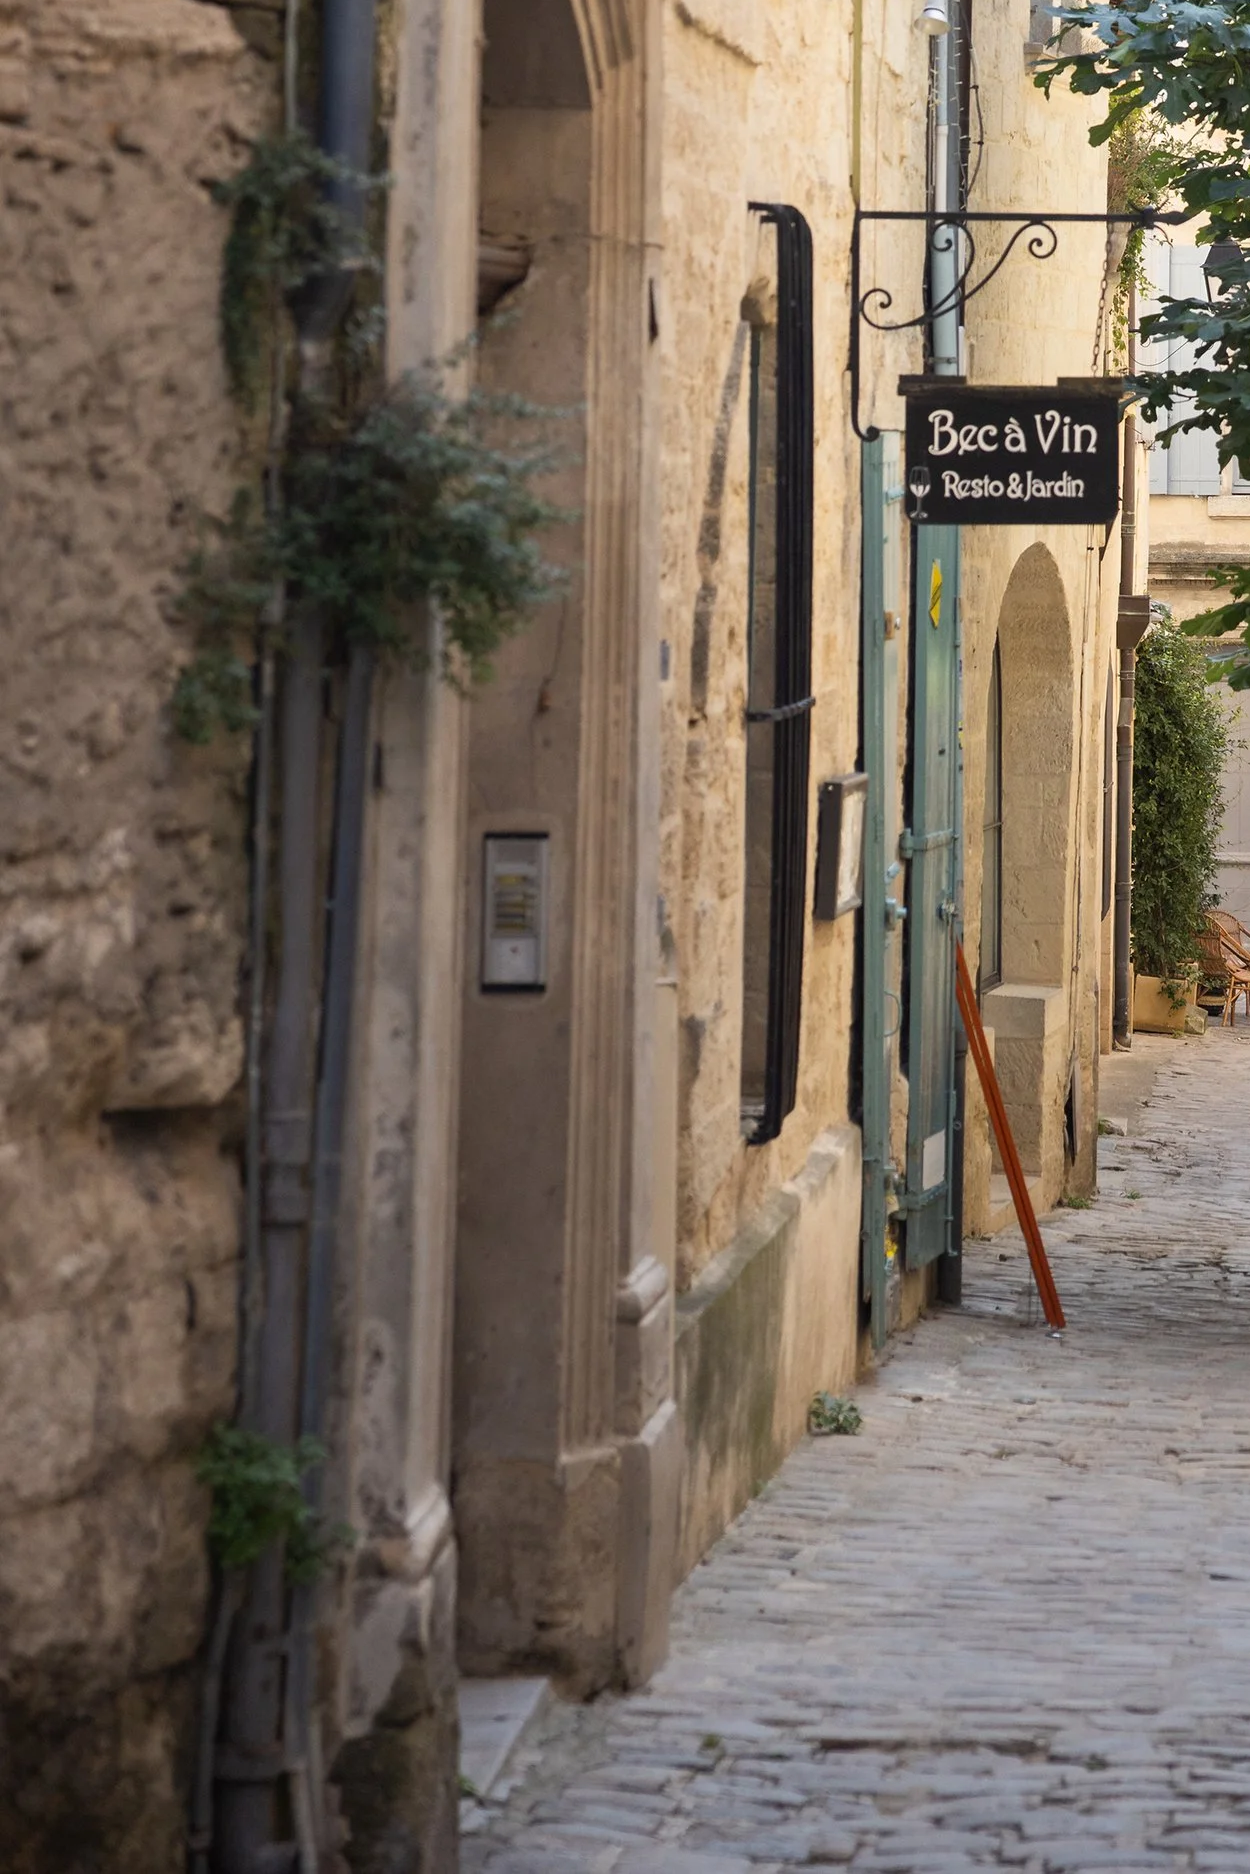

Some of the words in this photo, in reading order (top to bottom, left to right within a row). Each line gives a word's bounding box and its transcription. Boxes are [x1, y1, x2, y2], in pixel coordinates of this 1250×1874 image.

[927, 408, 999, 456] Bec
[1004, 416, 1028, 454] à
[1033, 409, 1099, 455] Vin
[941, 469, 1005, 501] Resto
[1024, 469, 1085, 503] Jardin
